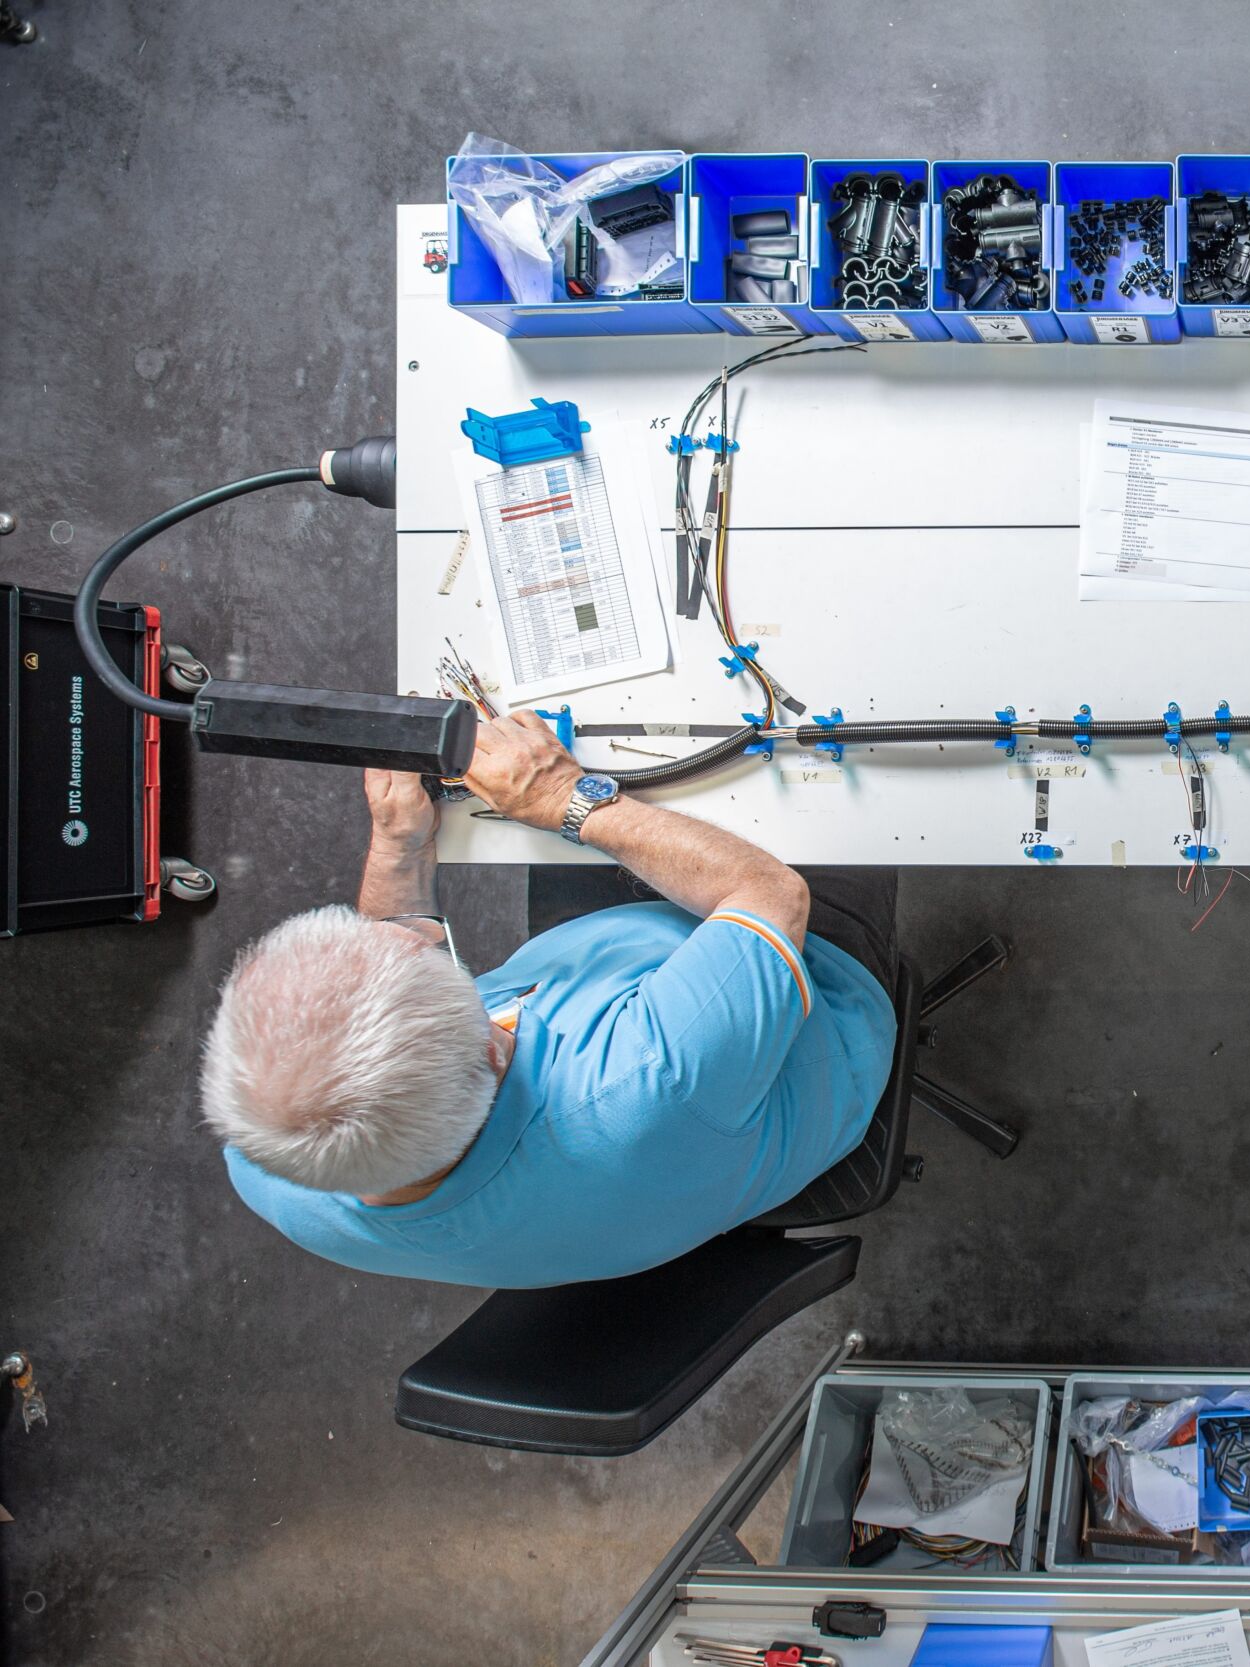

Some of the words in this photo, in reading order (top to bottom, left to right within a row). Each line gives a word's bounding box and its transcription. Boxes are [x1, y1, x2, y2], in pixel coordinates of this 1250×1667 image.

[649, 417, 671, 430] X5
[70, 675, 84, 723] Systems
[69, 724, 84, 788] Aerospace
[802, 771, 818, 782] V1
[1037, 767, 1052, 777] V2
[1064, 766, 1078, 777] R1
[69, 790, 82, 814] UTC
[1020, 832, 1042, 845] X23
